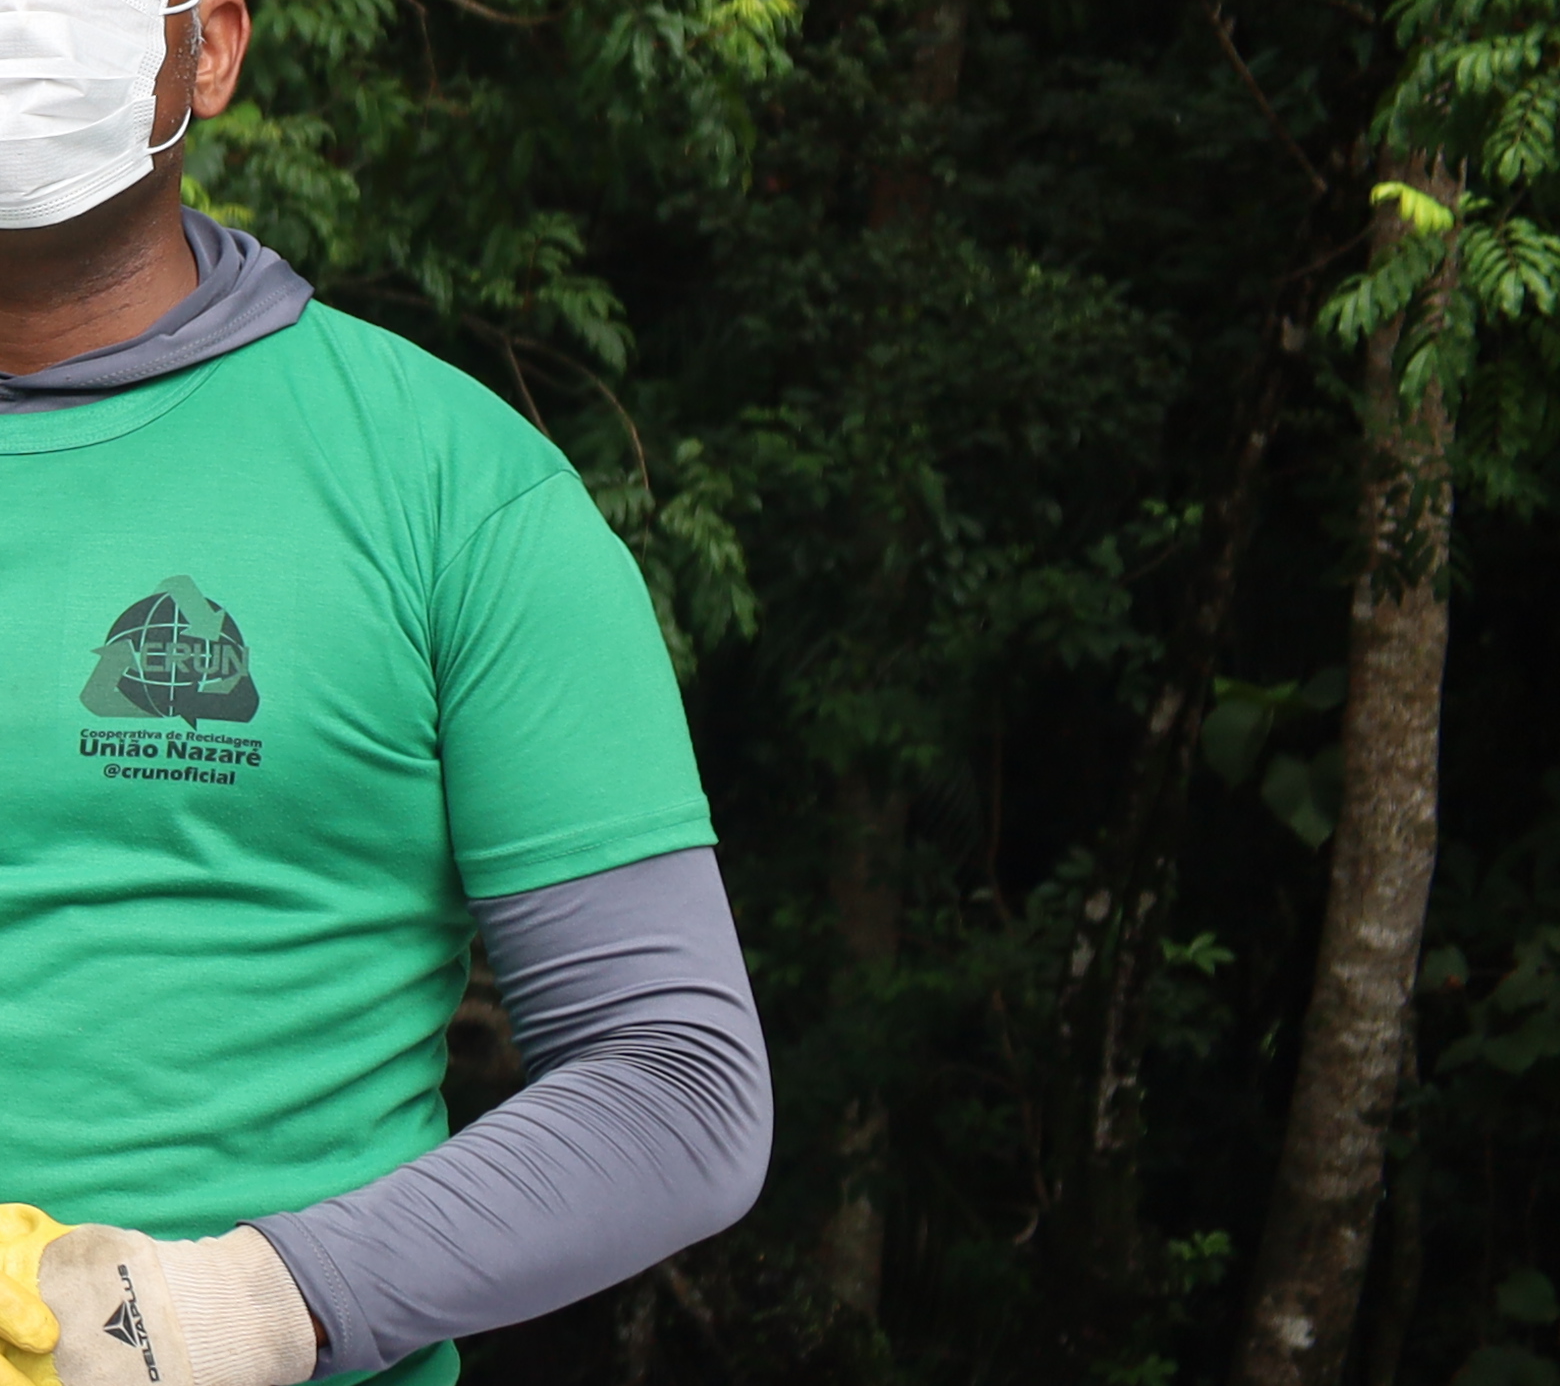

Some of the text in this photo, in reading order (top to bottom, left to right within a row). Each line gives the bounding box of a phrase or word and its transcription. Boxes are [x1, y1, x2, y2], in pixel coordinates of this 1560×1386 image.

[80, 728, 263, 750] Cooperativa de Reciclagem
[79, 739, 262, 768] União Nazaré
[103, 763, 237, 786] @crunoficial
